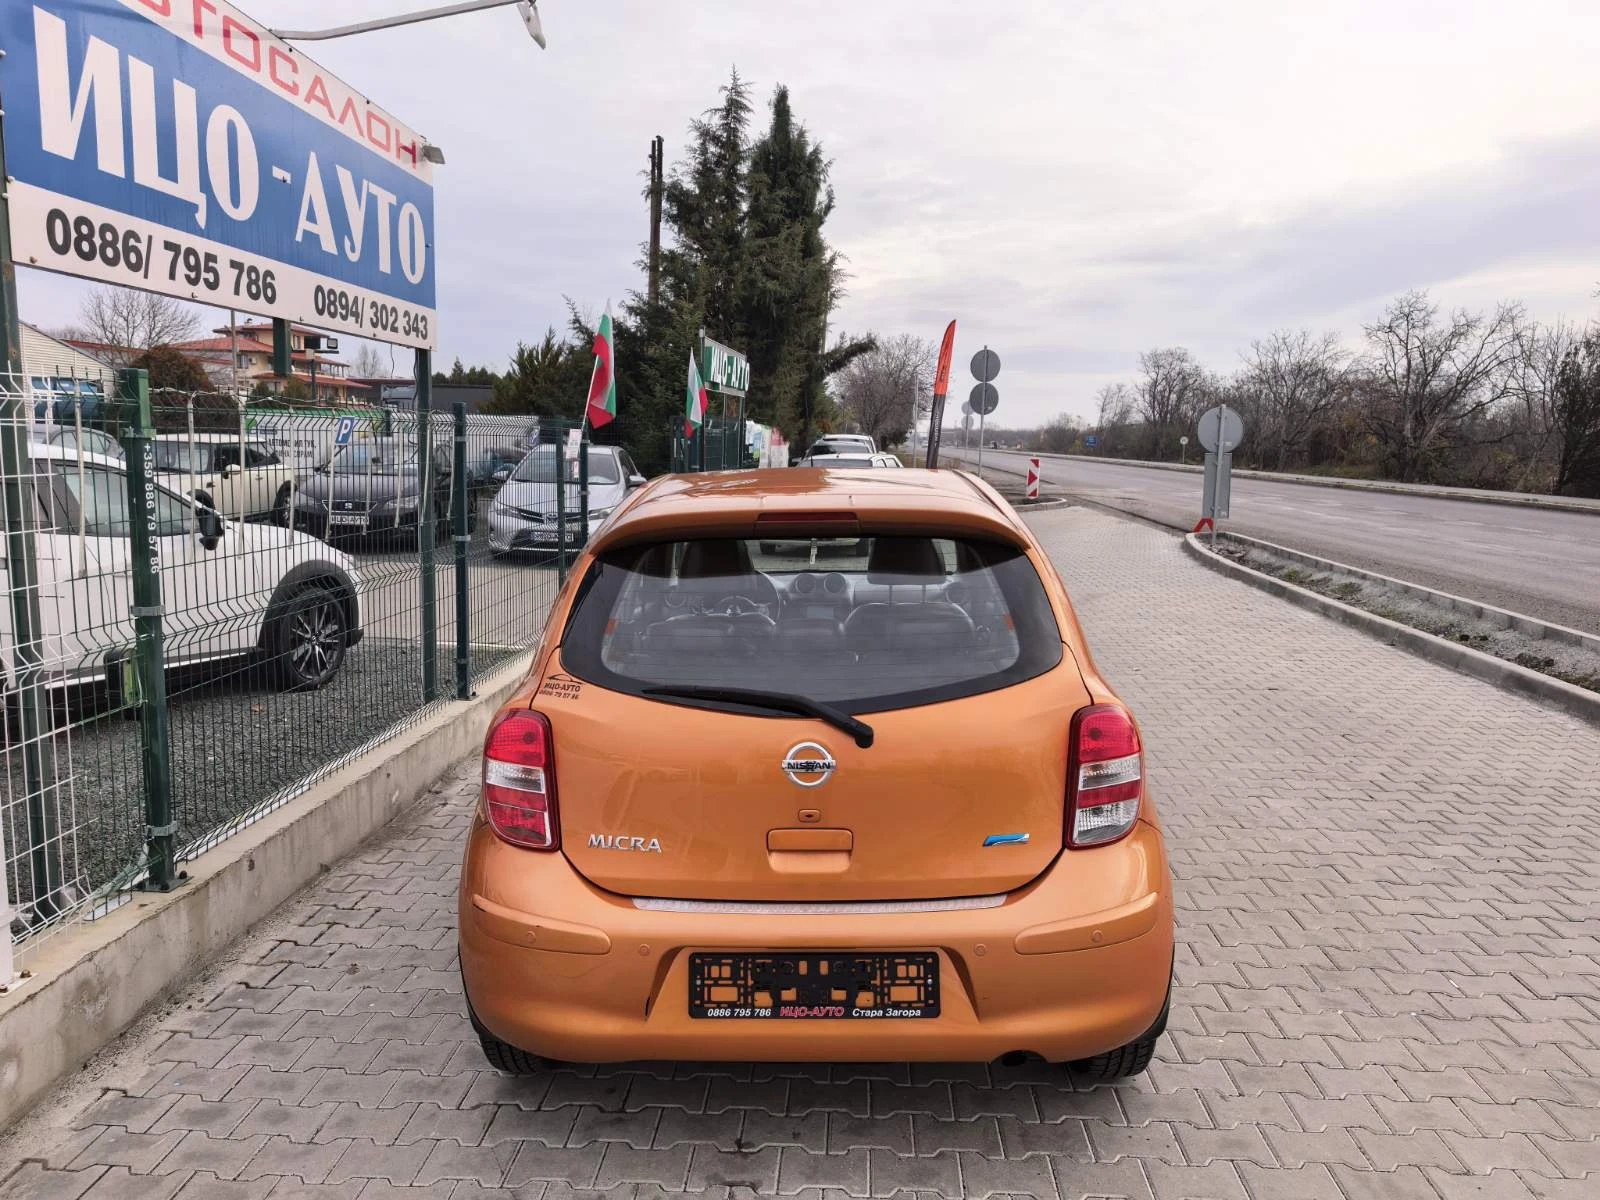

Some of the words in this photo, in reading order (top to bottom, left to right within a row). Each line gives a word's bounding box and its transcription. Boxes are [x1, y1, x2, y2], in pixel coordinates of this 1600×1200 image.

[46, 207, 154, 279] 0886/
[164, 240, 221, 292] 795
[230, 260, 277, 305] 786
[313, 285, 365, 329] 0894/
[370, 301, 399, 336] 302
[403, 309, 428, 341] 343
[710, 346, 750, 392] ИЦО-АУТО
[338, 419, 351, 441] P
[144, 442, 153, 478] +359
[145, 482, 155, 509] 886
[147, 513, 157, 531] 79
[149, 536, 158, 551] 57
[150, 557, 160, 574] 86
[544, 682, 581, 692] ИЦО-АУТО
[787, 761, 831, 771] NISSAN
[588, 833, 662, 854] MICRA
[707, 1008, 733, 1017] 0886
[733, 1008, 751, 1017] 795
[753, 1008, 771, 1017] 786
[779, 1007, 845, 1018] ИЦО-АУТО
[852, 1008, 883, 1018] Стара
[886, 1008, 921, 1018] Загора
